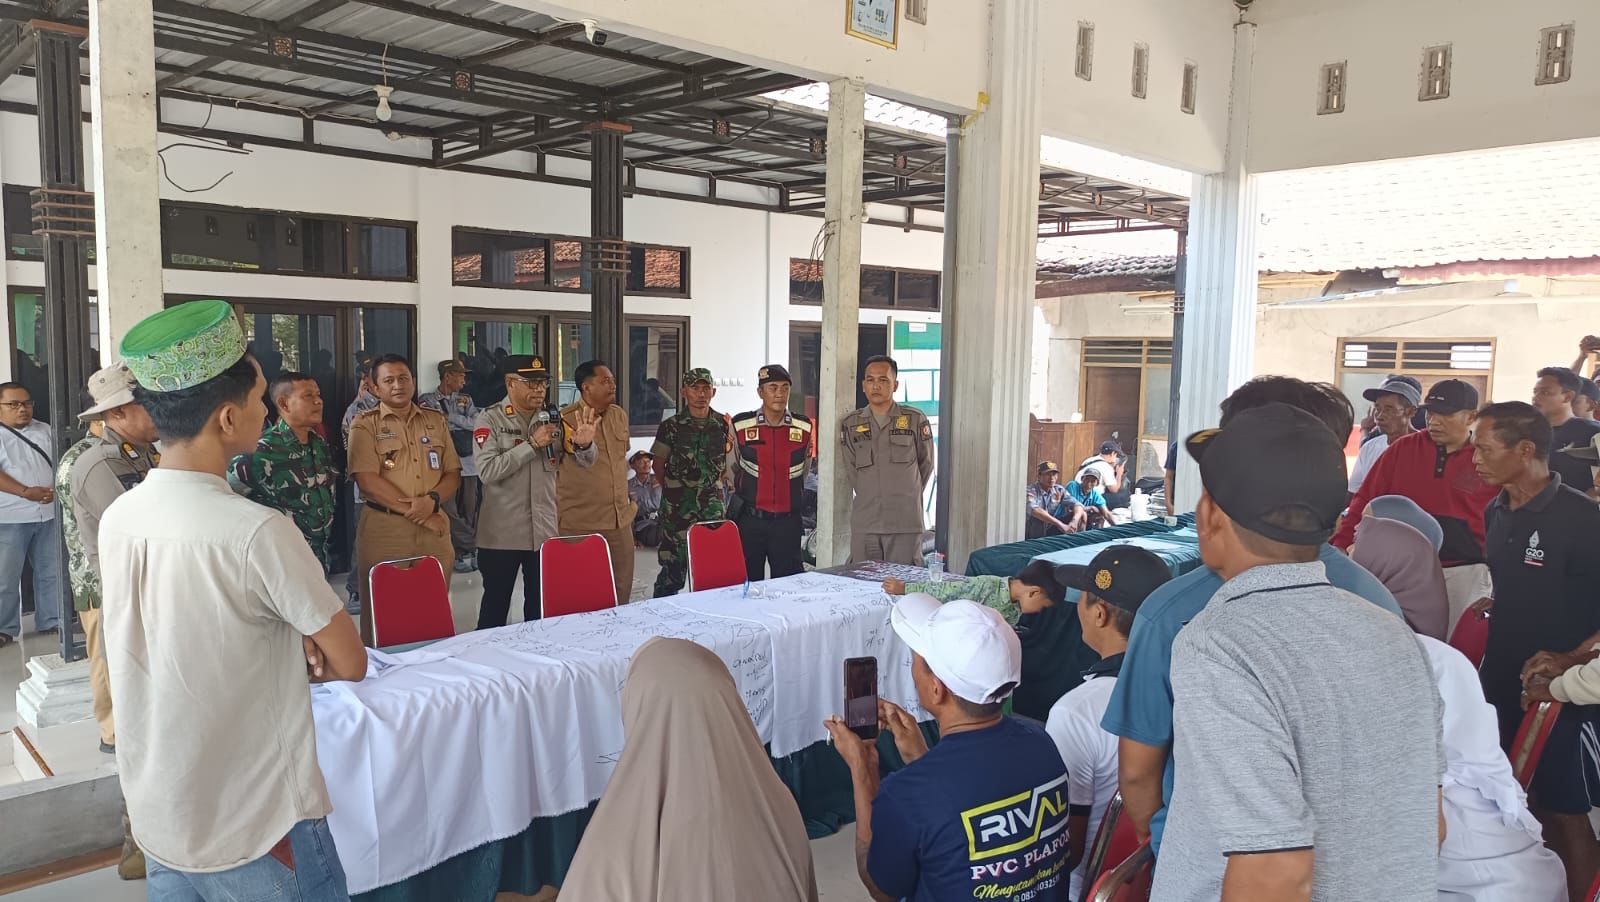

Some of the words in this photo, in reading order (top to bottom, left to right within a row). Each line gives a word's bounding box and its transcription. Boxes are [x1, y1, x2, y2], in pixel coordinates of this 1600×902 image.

[1525, 547, 1544, 557] G20
[979, 788, 1067, 843] RIVAL
[969, 858, 1019, 880] PVC
